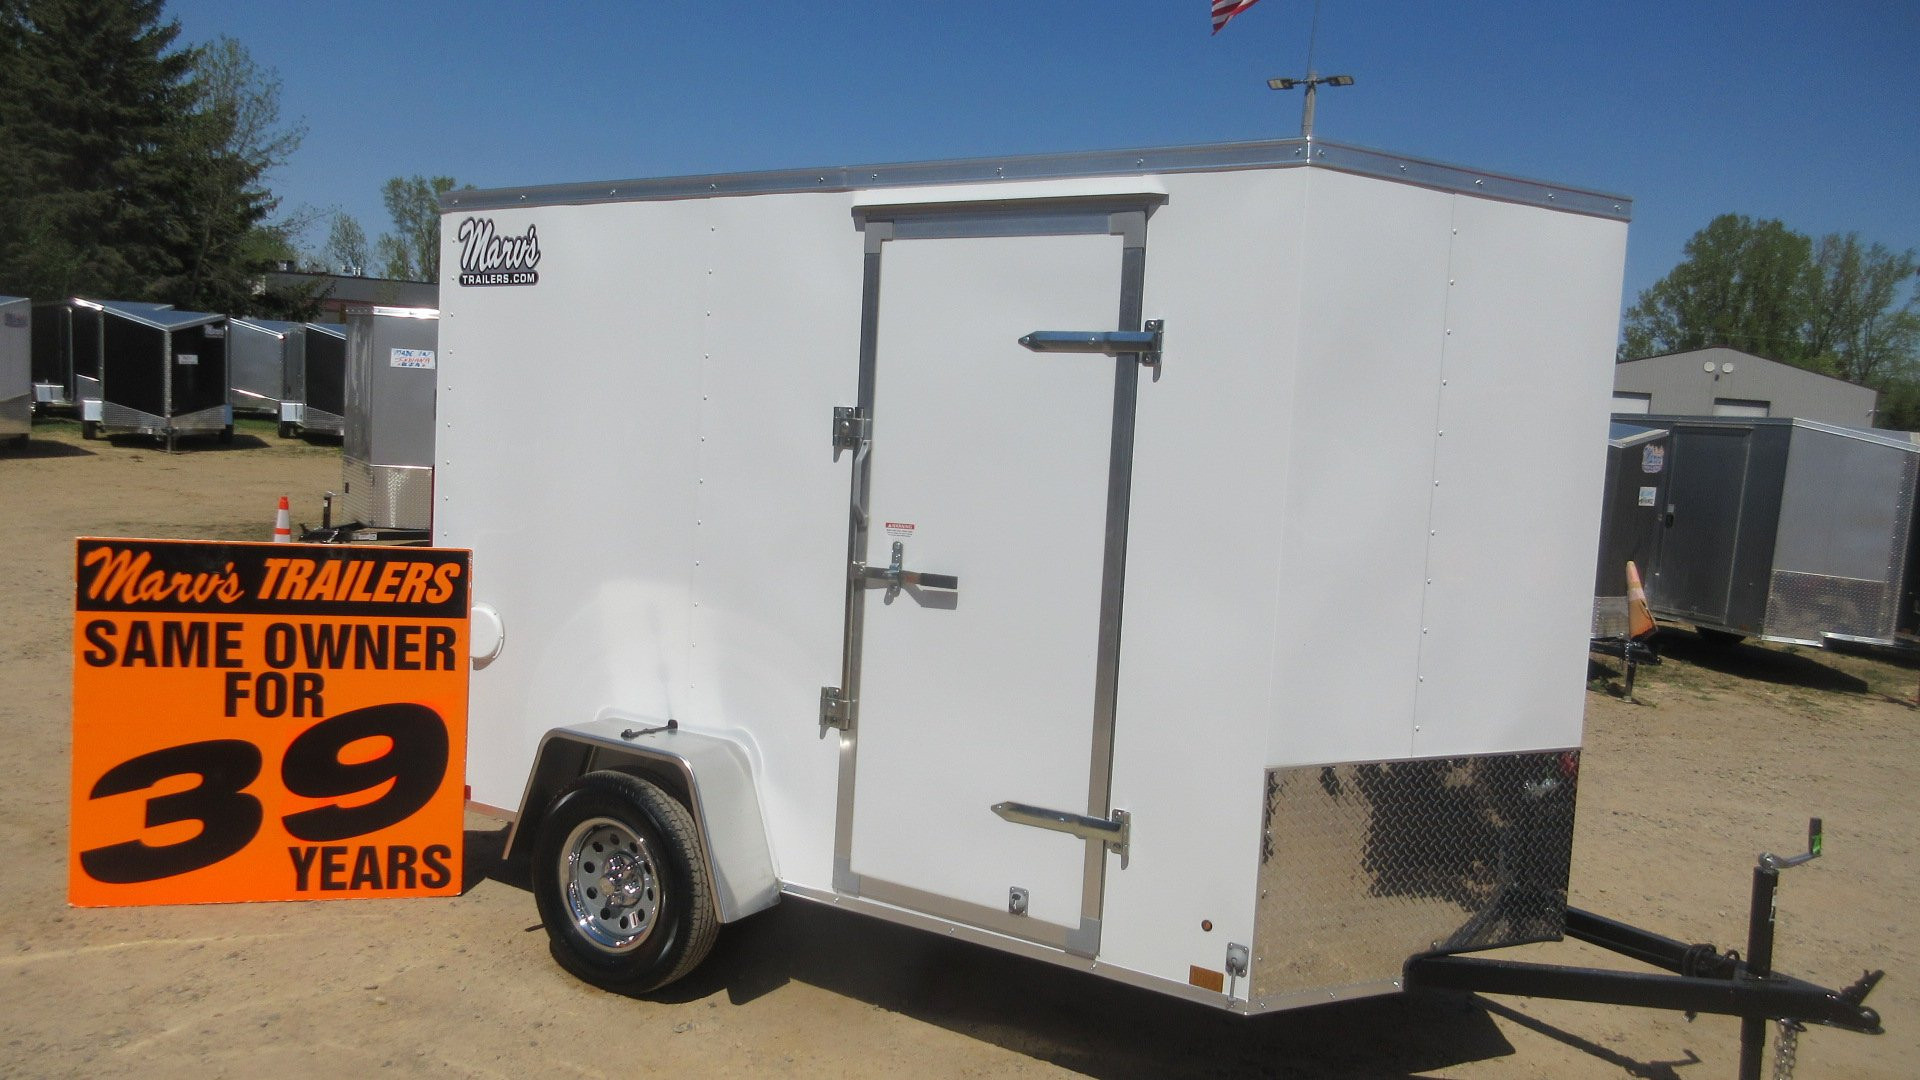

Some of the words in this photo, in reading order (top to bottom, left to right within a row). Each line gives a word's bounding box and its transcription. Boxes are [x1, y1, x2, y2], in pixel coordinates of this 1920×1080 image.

[459, 217, 540, 272] Marv's
[462, 273, 535, 285] TRAILERS.COM
[84, 547, 244, 604] Marv's
[258, 558, 460, 604] TRAILERS
[84, 620, 244, 668] SAME
[264, 623, 456, 671] OWNER
[225, 672, 325, 718] FOR
[80, 702, 449, 884] 39
[288, 845, 452, 891] YEARS
